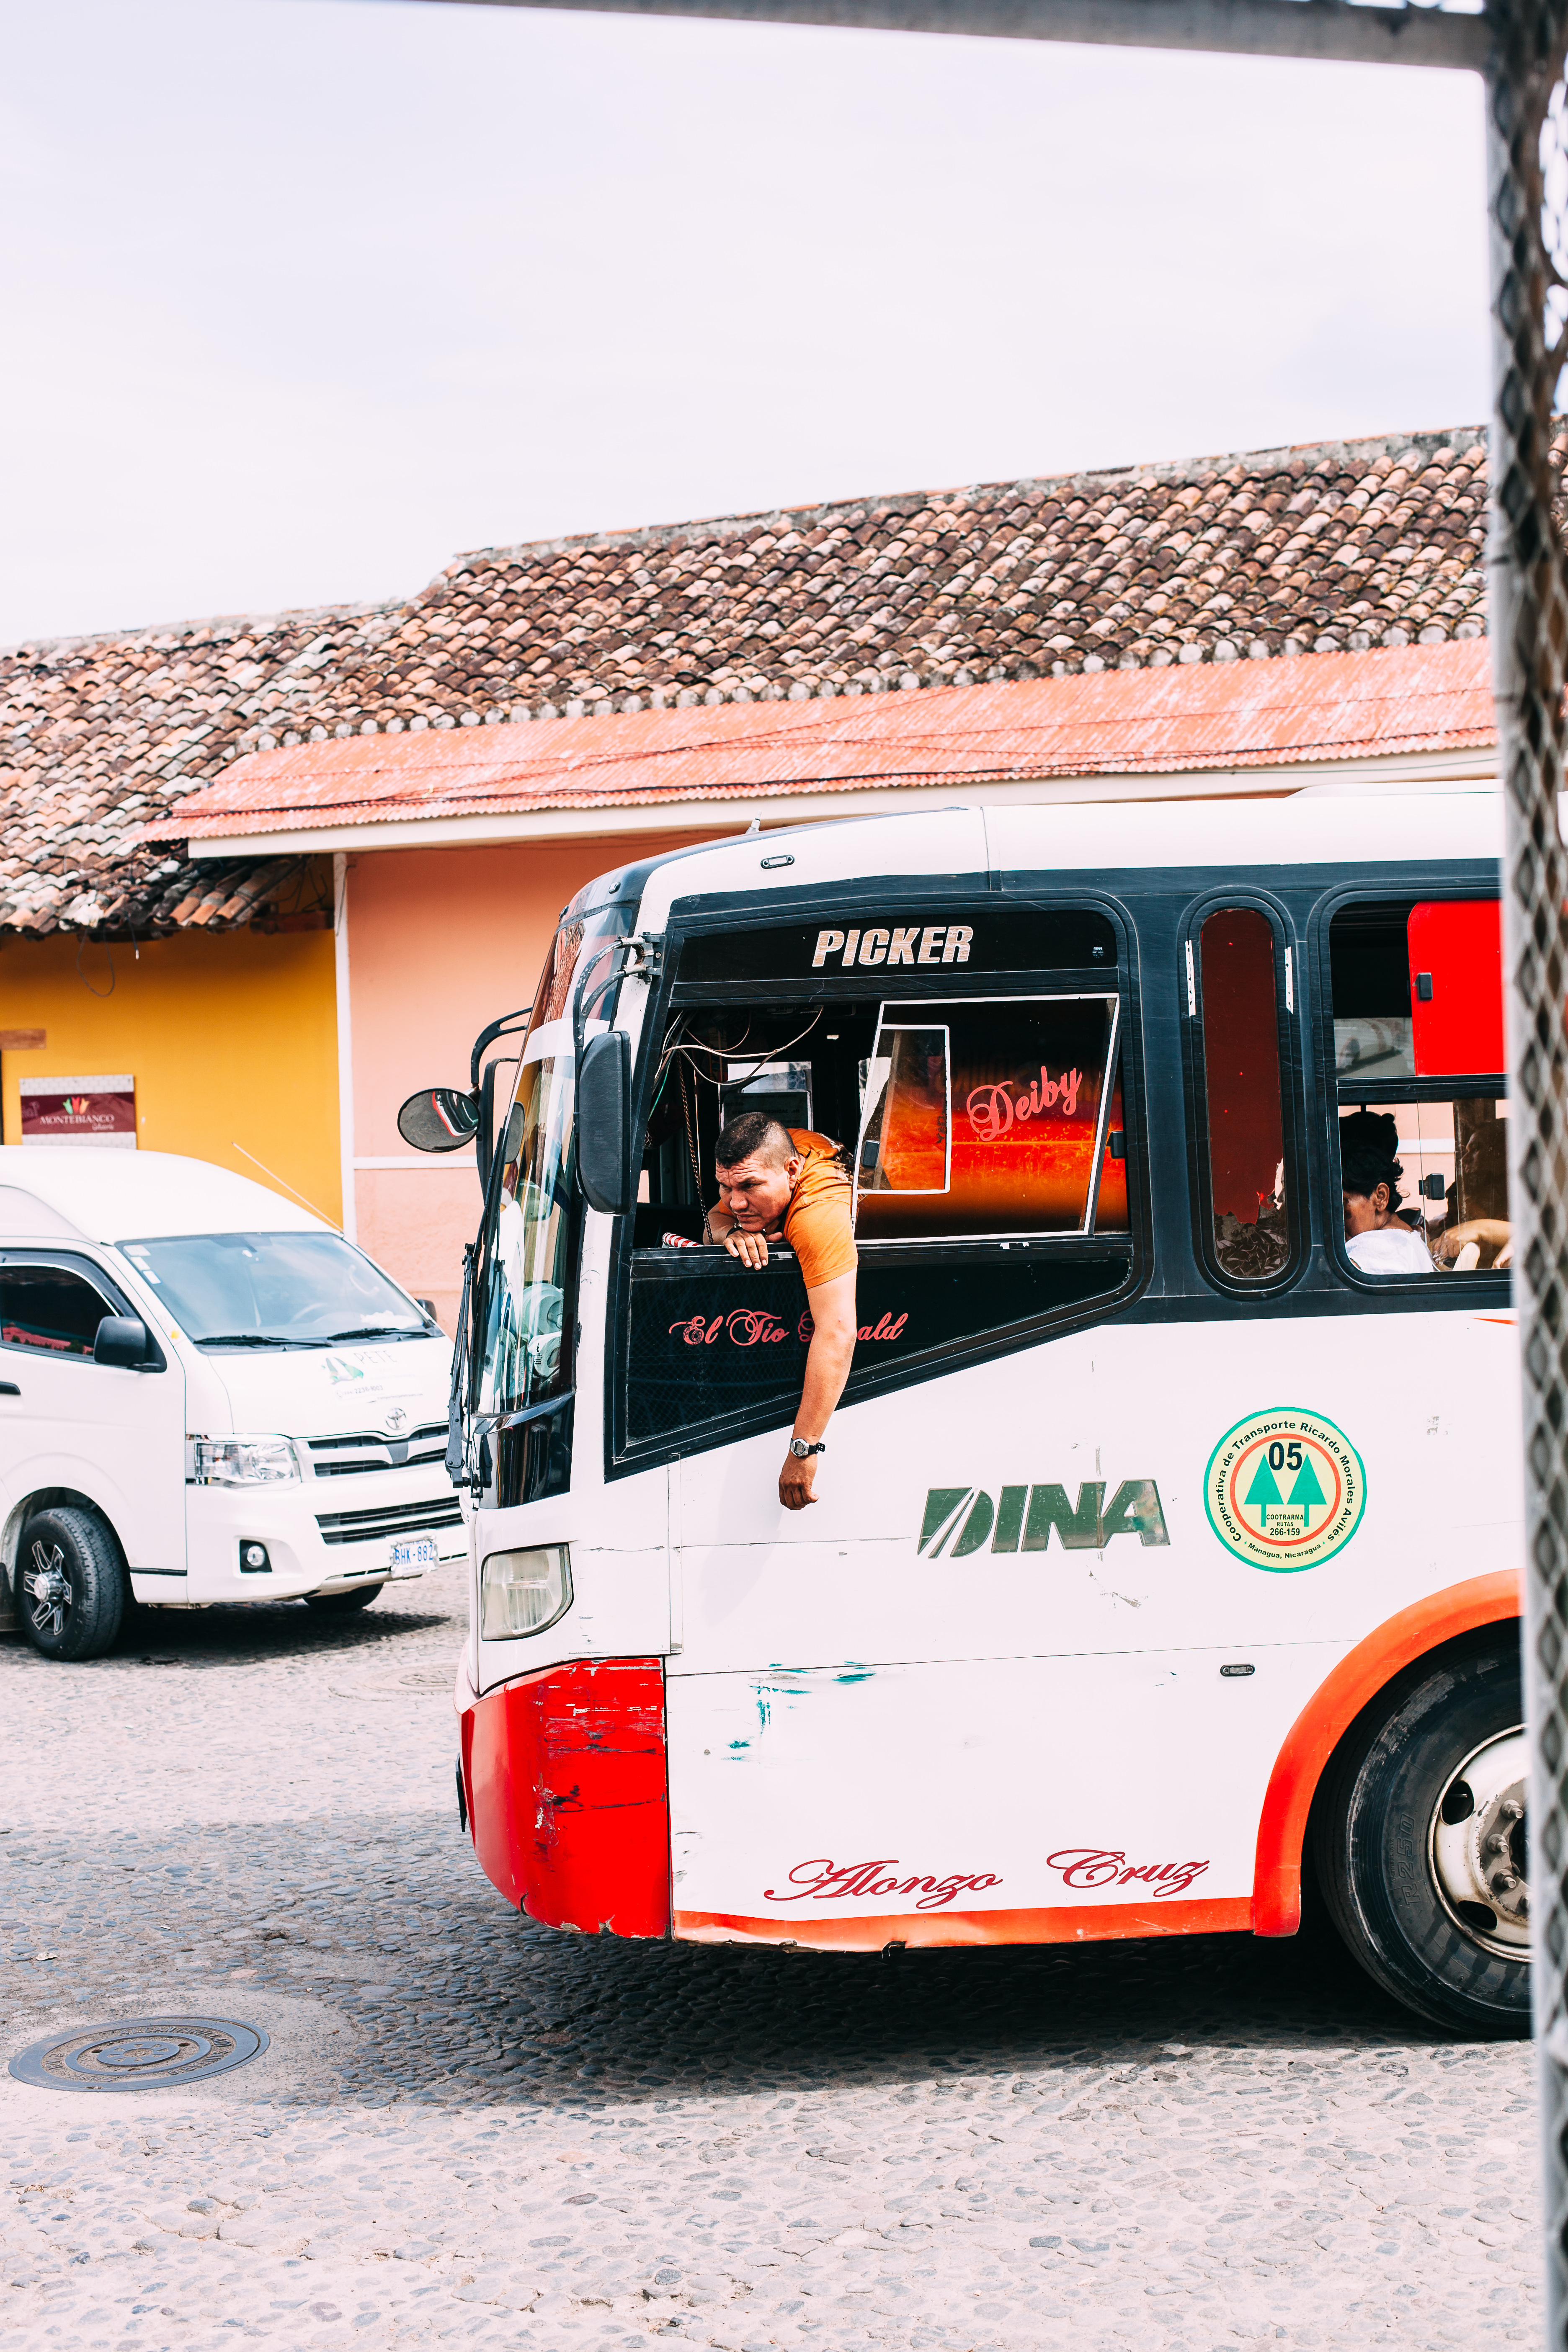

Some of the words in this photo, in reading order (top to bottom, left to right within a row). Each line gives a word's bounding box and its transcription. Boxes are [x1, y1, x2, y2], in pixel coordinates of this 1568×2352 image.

[812, 925, 974, 967] PICKER
[966, 1065, 1083, 1142] Deiby
[669, 1315, 723, 1345] El
[726, 1309, 789, 1346] Tio
[353, 1350, 397, 1364] PETE
[1232, 1420, 1296, 1450] Transporte
[1300, 1422, 1341, 1454] Ricardo
[1223, 1453, 1234, 1466] de
[1268, 1442, 1302, 1471] 05
[1339, 1455, 1355, 1504] Morales
[917, 1478, 1171, 1559] DINA
[1216, 1470, 1242, 1542] Cooperativa
[1270, 1528, 1300, 1536] 266-159
[1328, 1508, 1352, 1542] Avilés
[1248, 1543, 1282, 1559] Managua,
[1284, 1543, 1321, 1558] Nicaragua
[1397, 1813, 1421, 1906] R250
[763, 1859, 1003, 1909] Alonzo
[1046, 1849, 1210, 1898] Cruz
